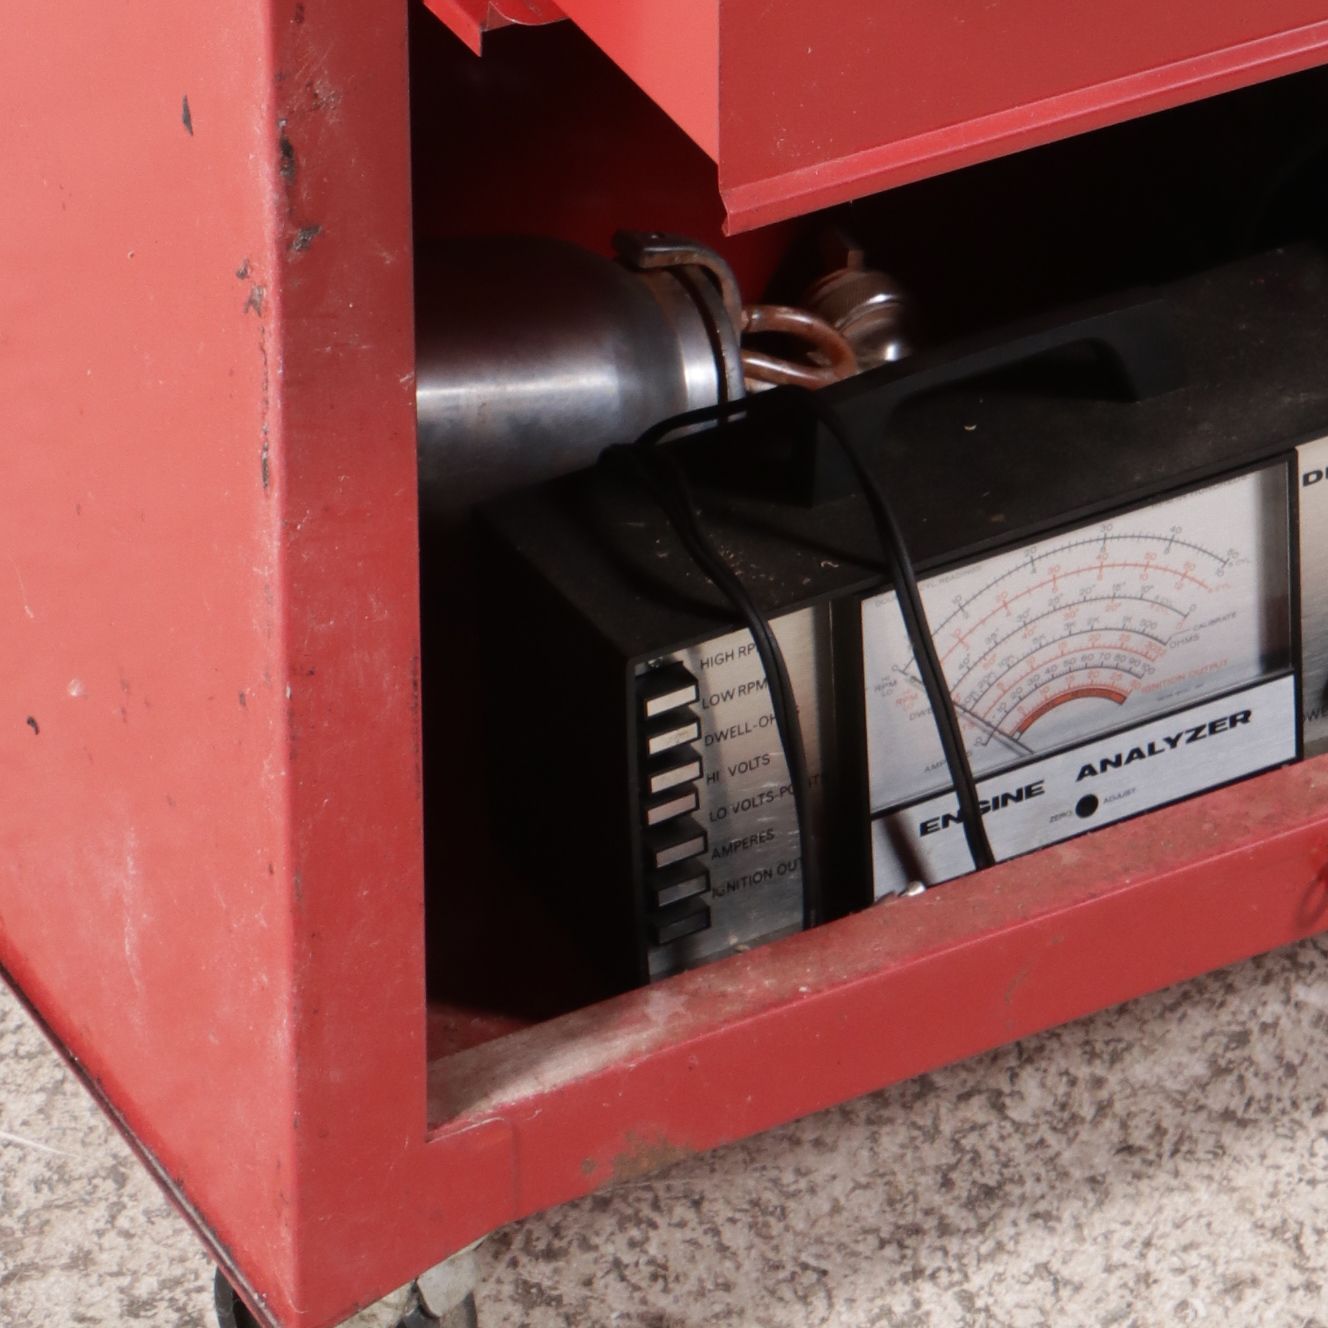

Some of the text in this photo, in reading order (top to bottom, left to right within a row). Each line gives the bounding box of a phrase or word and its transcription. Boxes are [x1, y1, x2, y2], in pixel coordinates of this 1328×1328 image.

[699, 641, 762, 672] HIGH RP
[1169, 633, 1200, 648] OHMS
[701, 677, 769, 710] LOW RPM
[704, 711, 778, 748] DWELL-OH
[1075, 707, 1253, 784] ANALYZER
[706, 752, 771, 785] HI VOLTS
[708, 803, 727, 823] LO
[919, 779, 1045, 837] ENGINE
[1049, 787, 1137, 824] ZERO ADJUST
[711, 827, 775, 860] AMPERES
[712, 867, 773, 898] IGNITION
